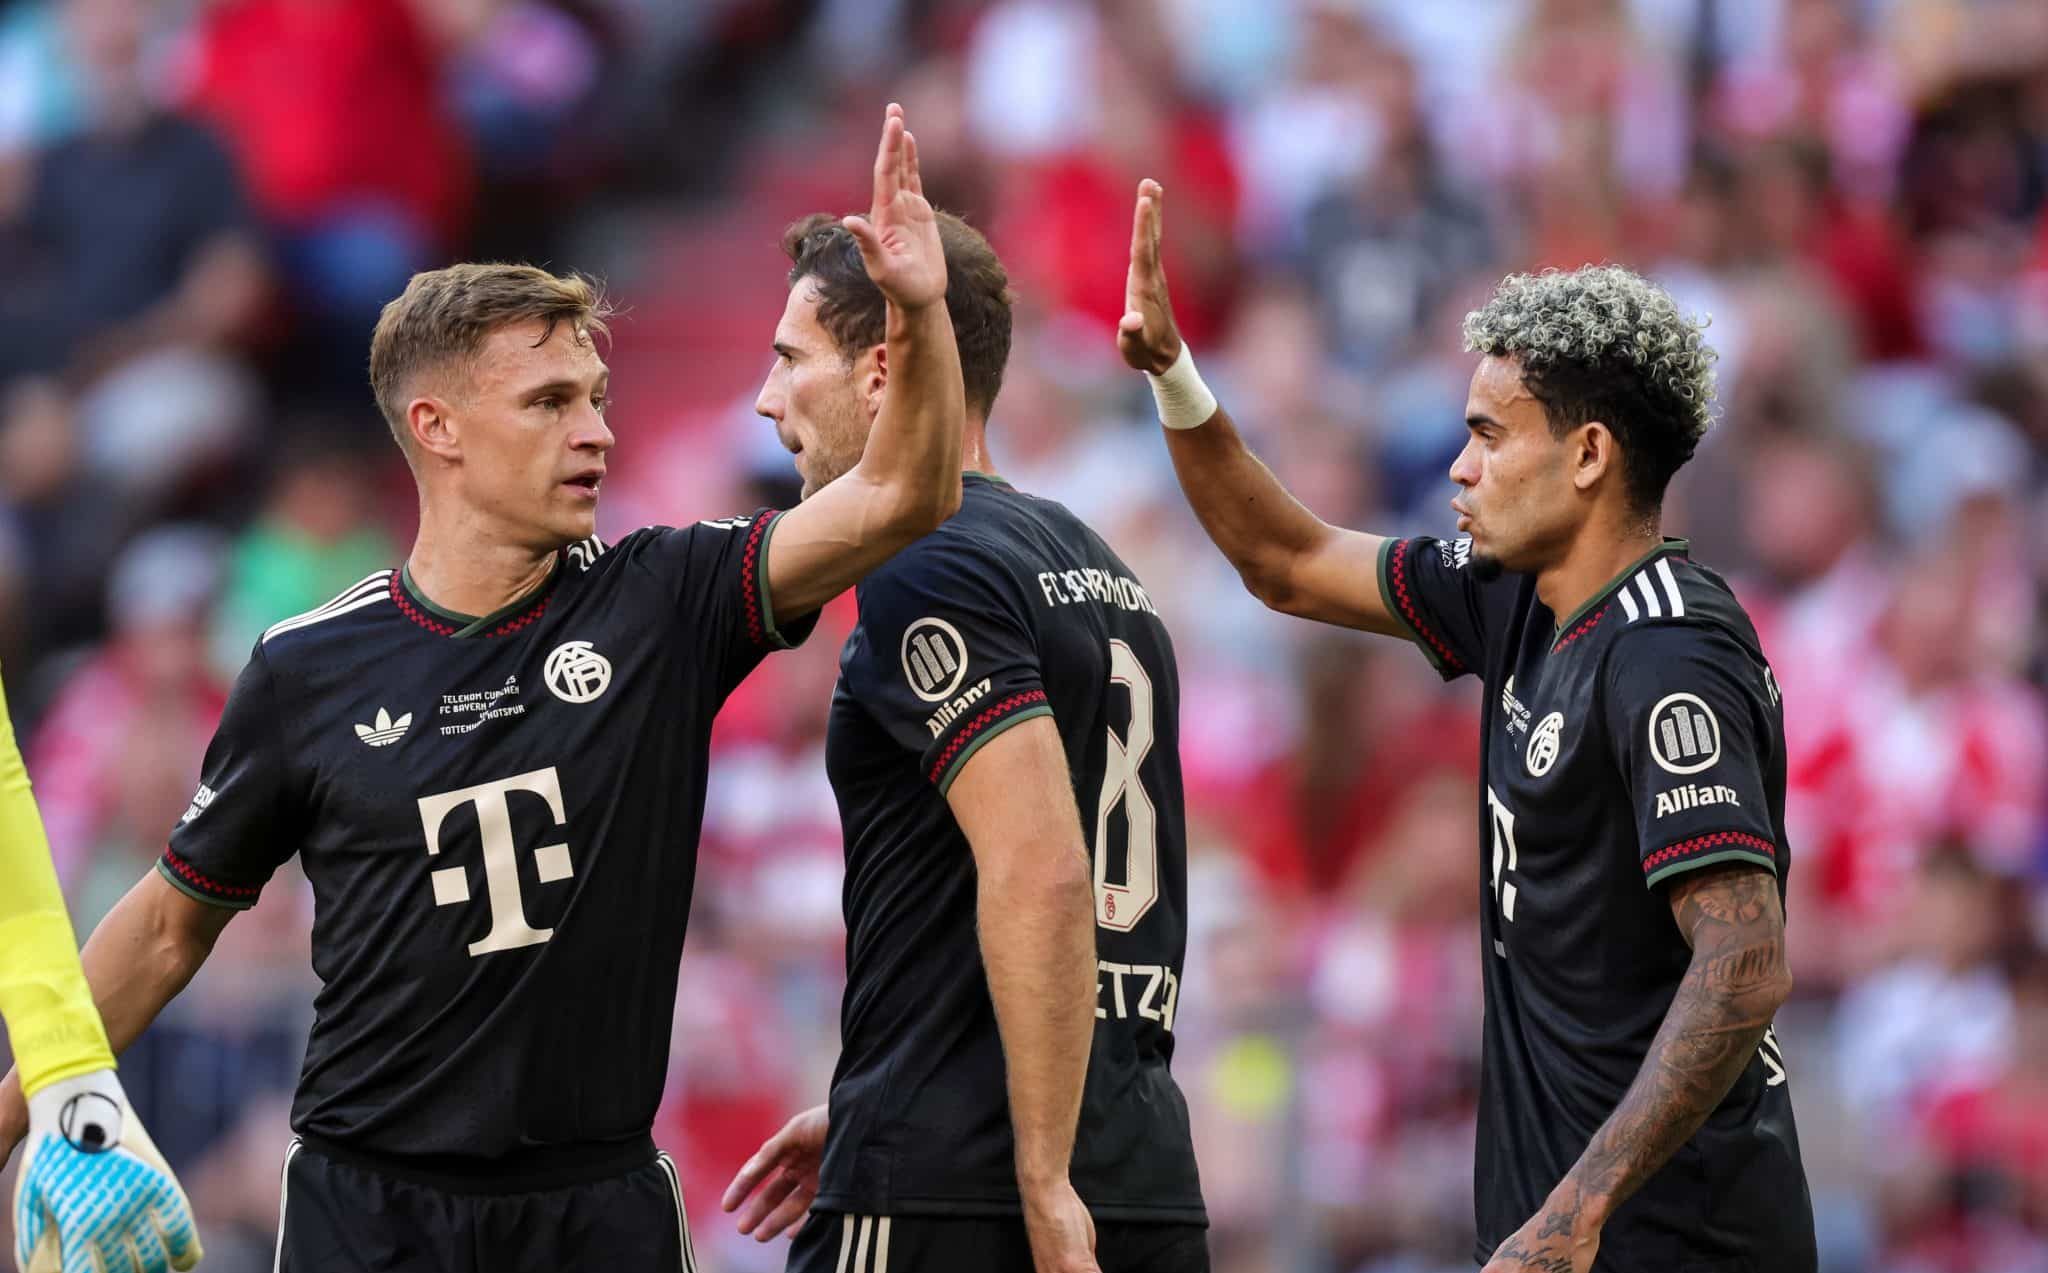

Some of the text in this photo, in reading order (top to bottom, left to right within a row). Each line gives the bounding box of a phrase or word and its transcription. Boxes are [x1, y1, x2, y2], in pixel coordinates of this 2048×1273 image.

[1038, 571, 1070, 607] FC
[440, 705, 452, 715] FC
[453, 702, 487, 713] BAYERN
[442, 693, 482, 705] TELEKOM
[926, 677, 992, 740] Allianz
[1094, 638, 1158, 933] 8
[1655, 783, 1741, 819] Allianz
[416, 765, 575, 958] T
